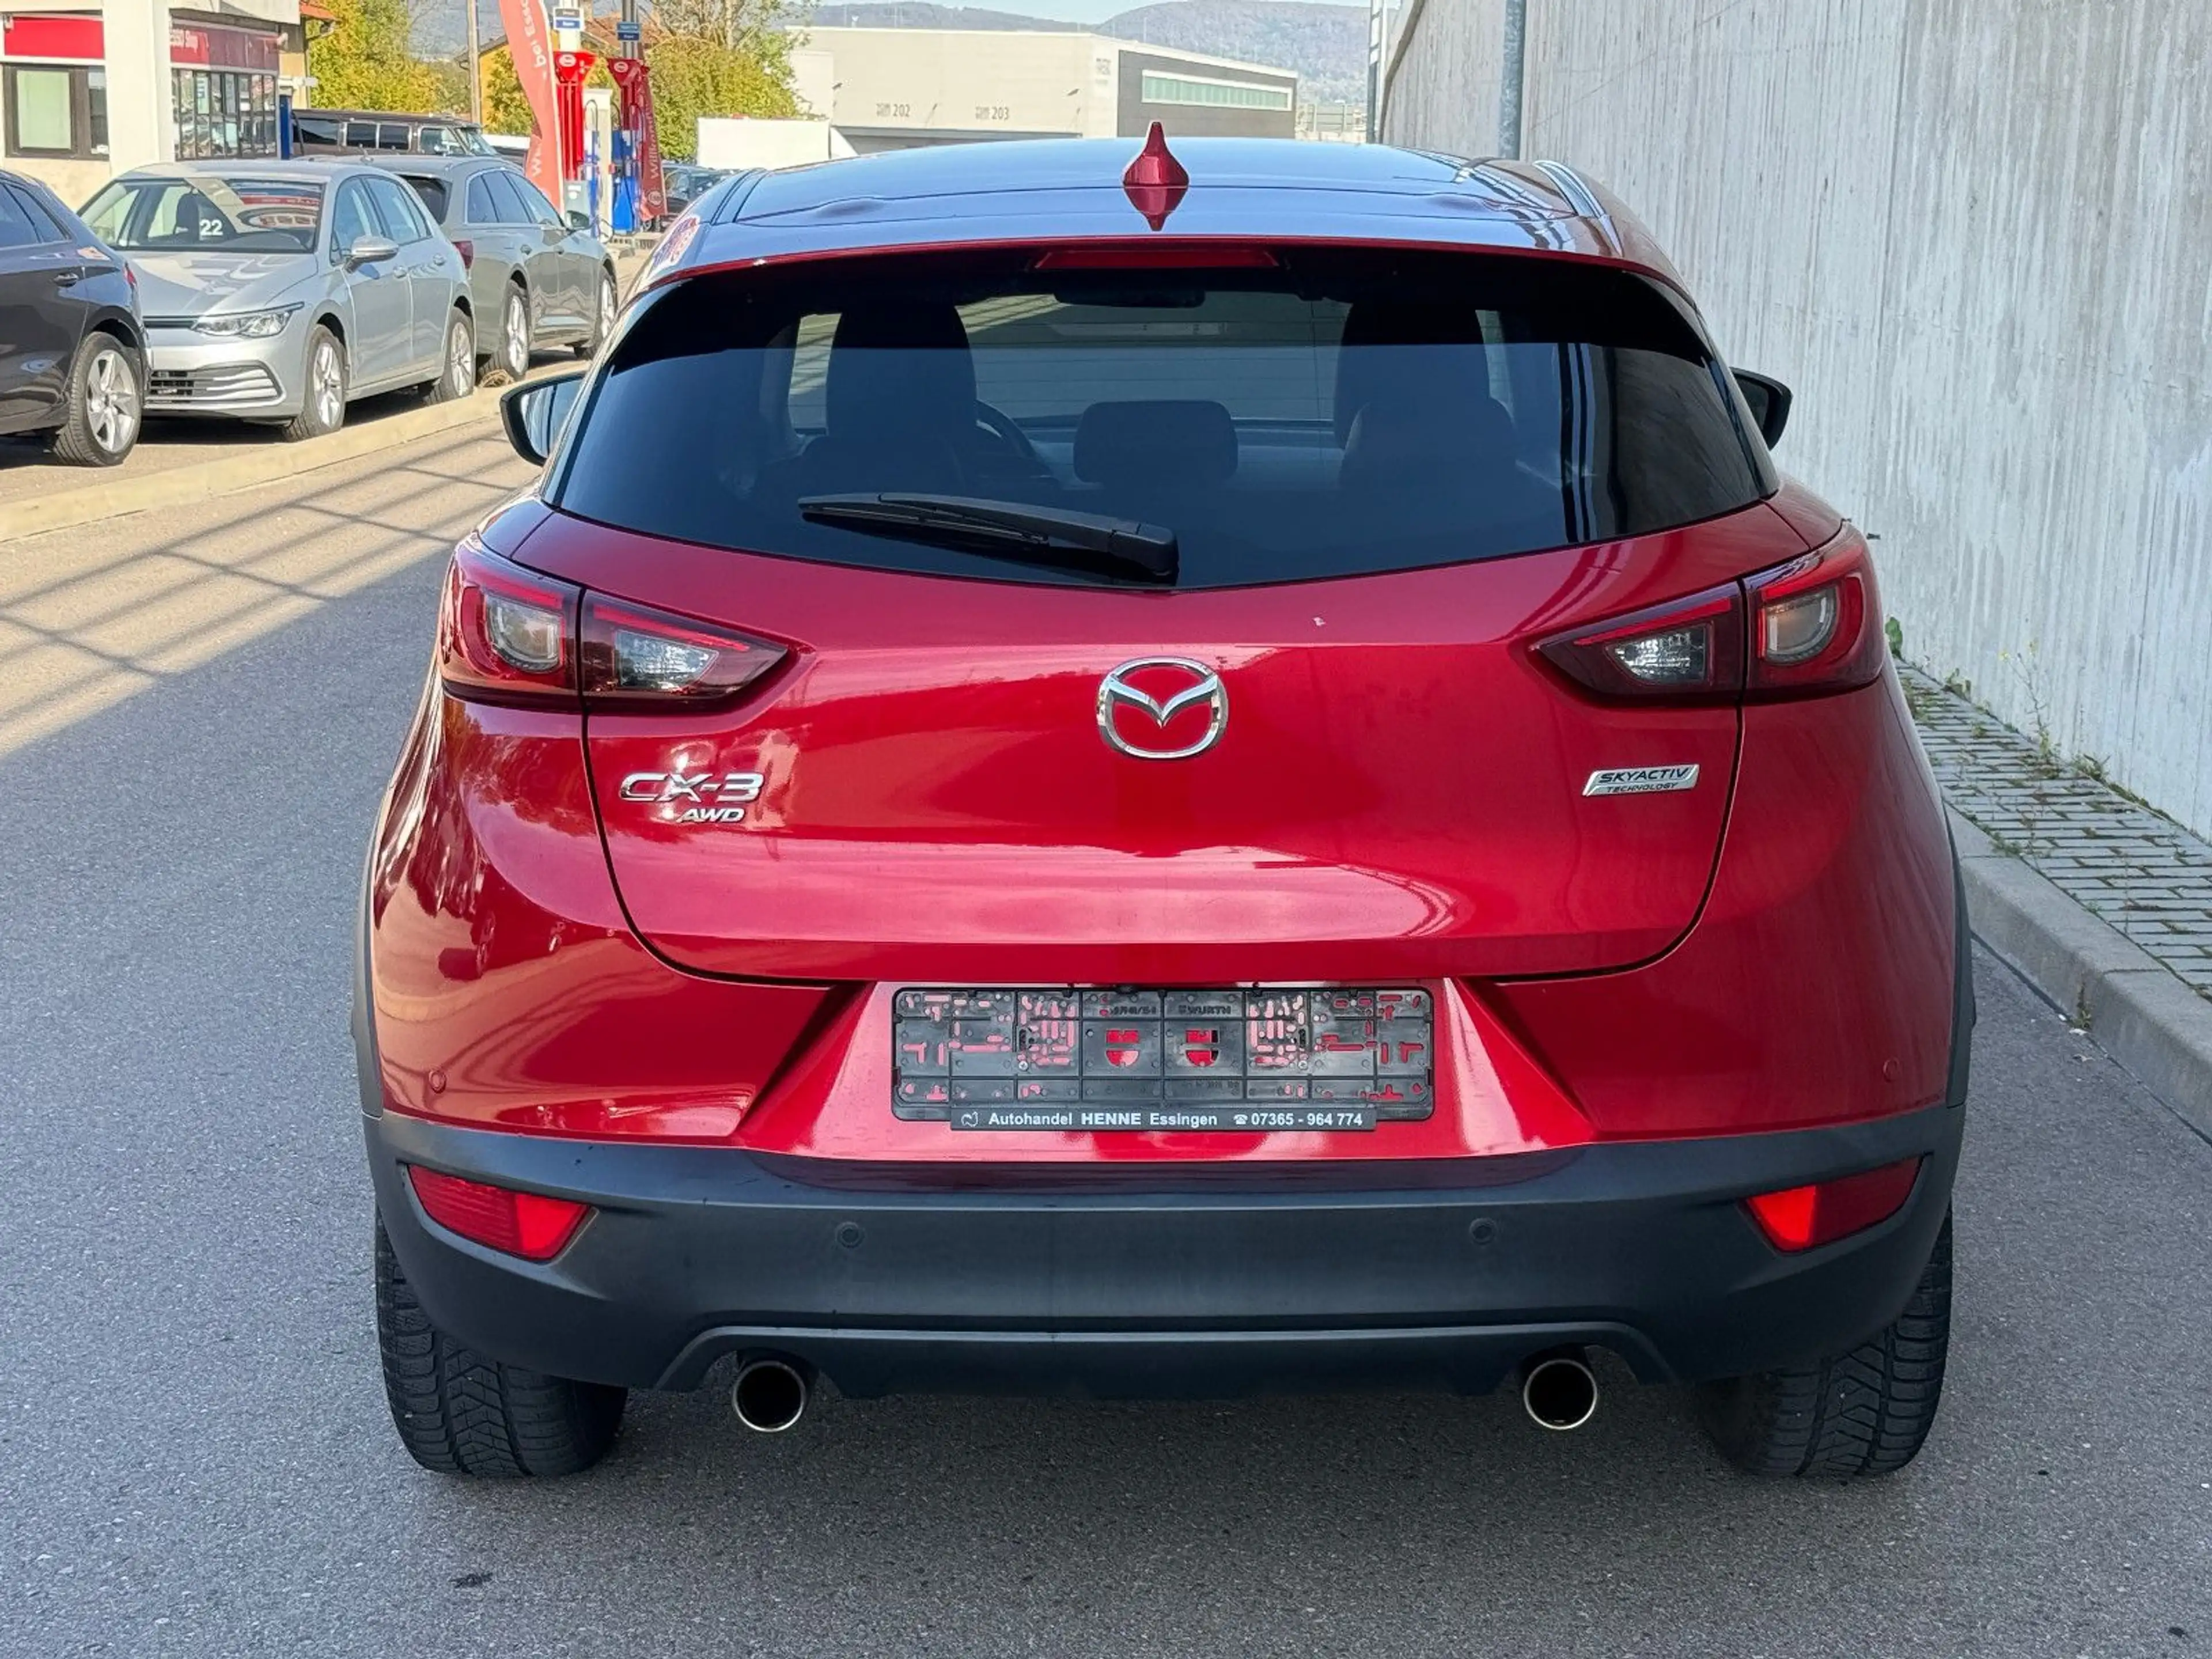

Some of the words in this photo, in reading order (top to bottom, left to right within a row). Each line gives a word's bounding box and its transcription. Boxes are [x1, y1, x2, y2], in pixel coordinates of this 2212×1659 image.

[893, 104, 910, 117] 202
[991, 107, 1009, 120] 203
[200, 219, 223, 236] 22
[1599, 768, 1689, 783] SKYACTIV
[619, 773, 764, 802] CX-3
[1608, 782, 1678, 793] TECHNOLOGY
[676, 808, 745, 823] AWD
[988, 1112, 1072, 1124] Autohandel
[1081, 1113, 1141, 1124] HENNE
[1150, 1112, 1217, 1128] Essingen
[1251, 1113, 1293, 1125] 07365
[1307, 1113, 1333, 1125] 964
[1336, 1113, 1362, 1125] 774
